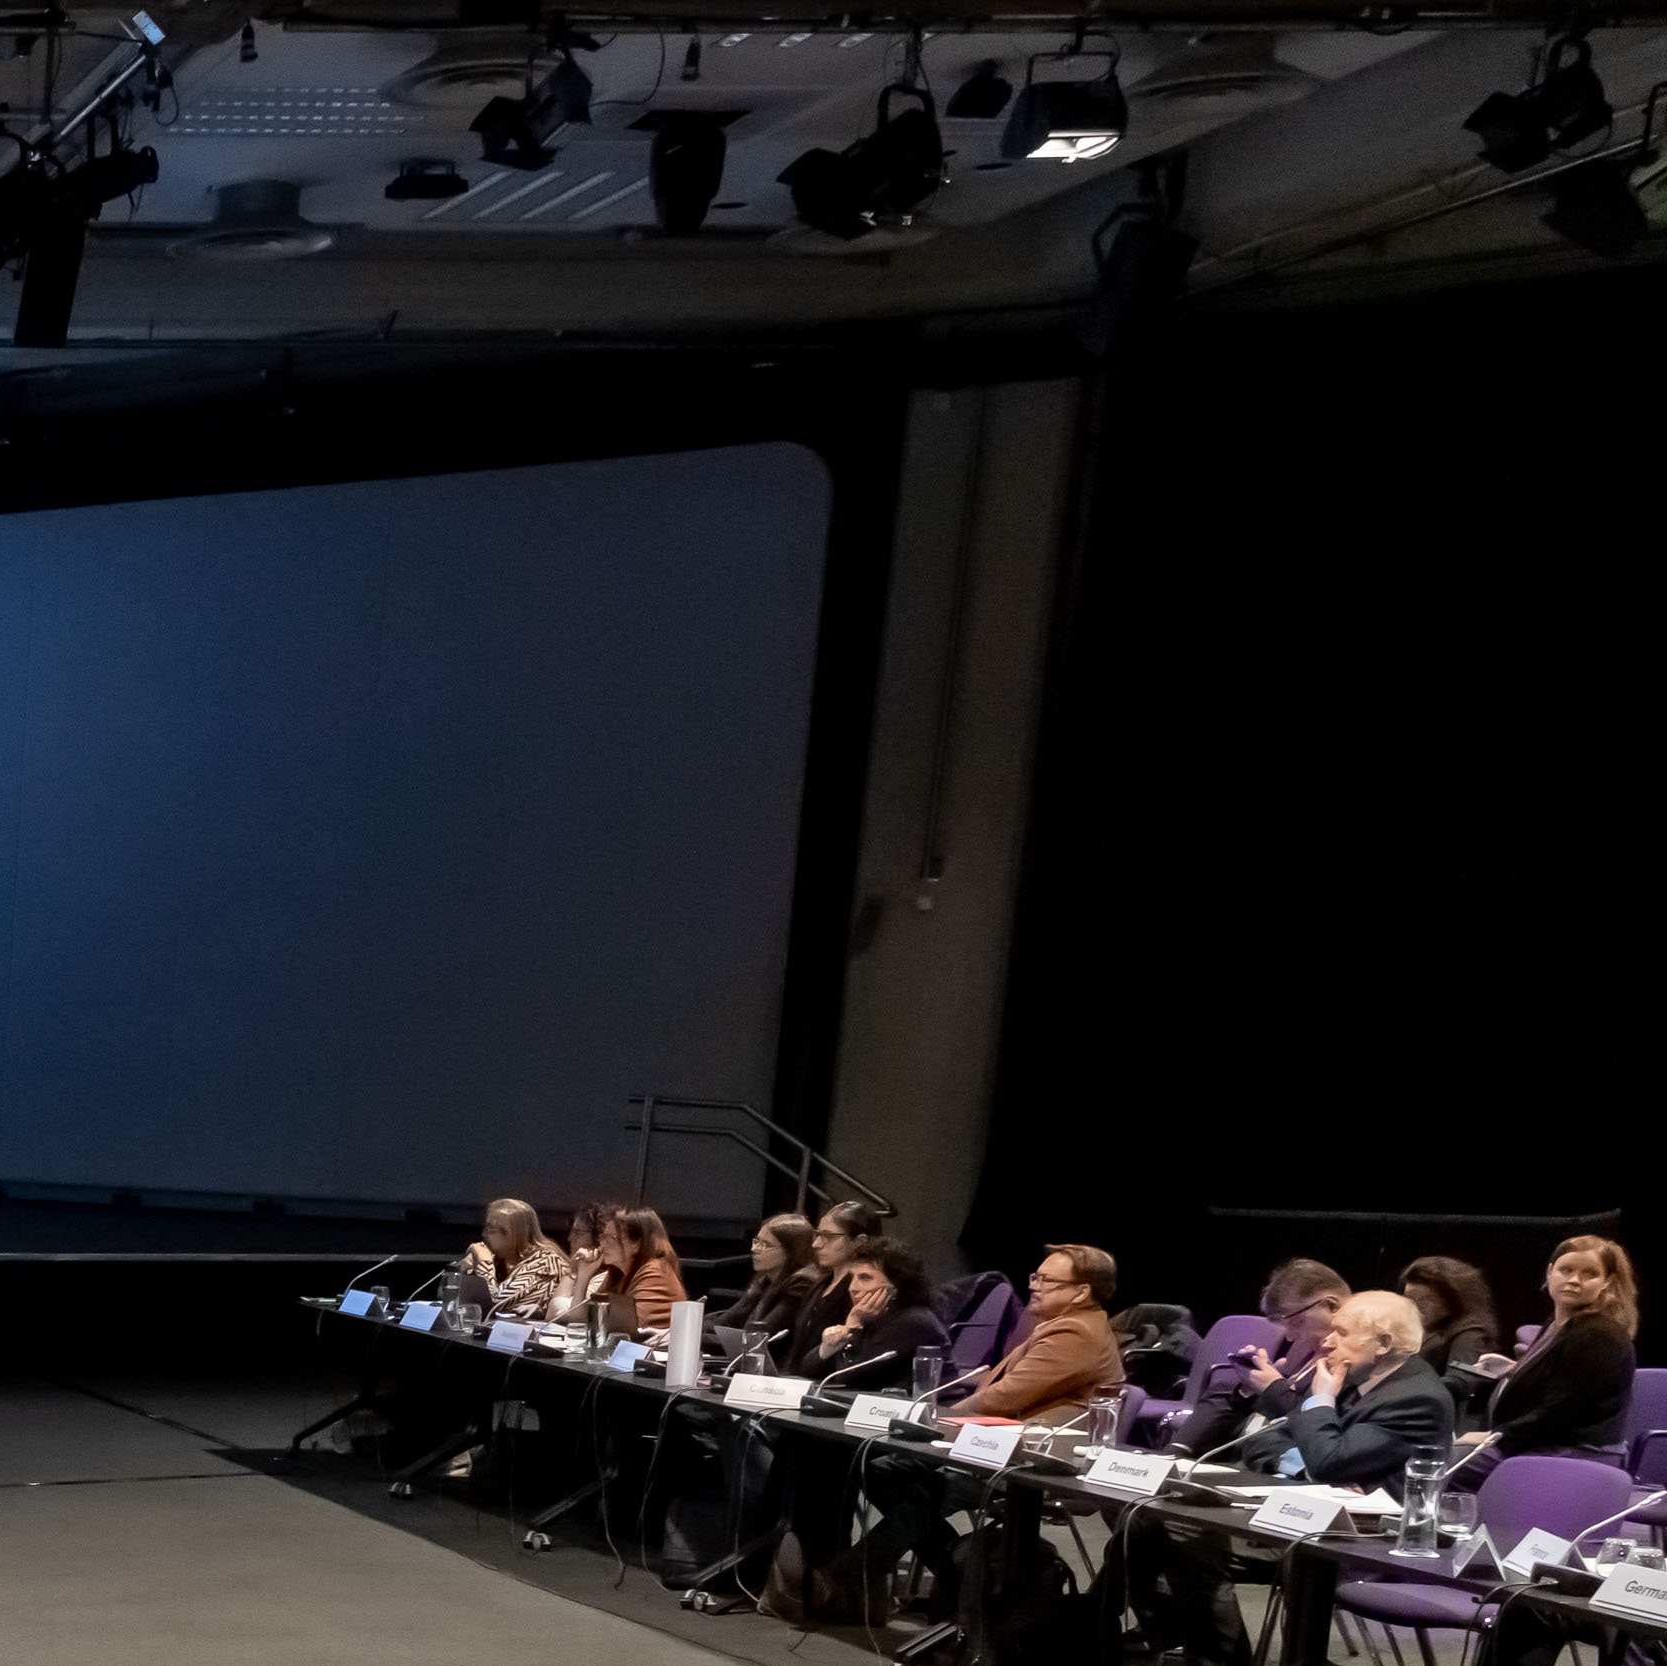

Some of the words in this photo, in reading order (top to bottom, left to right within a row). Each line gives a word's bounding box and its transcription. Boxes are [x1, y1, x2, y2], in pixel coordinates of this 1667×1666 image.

[1107, 1461, 1149, 1479] Denmark
[1279, 1503, 1315, 1520] Estonia
[1625, 1580, 1667, 1600] Germa
